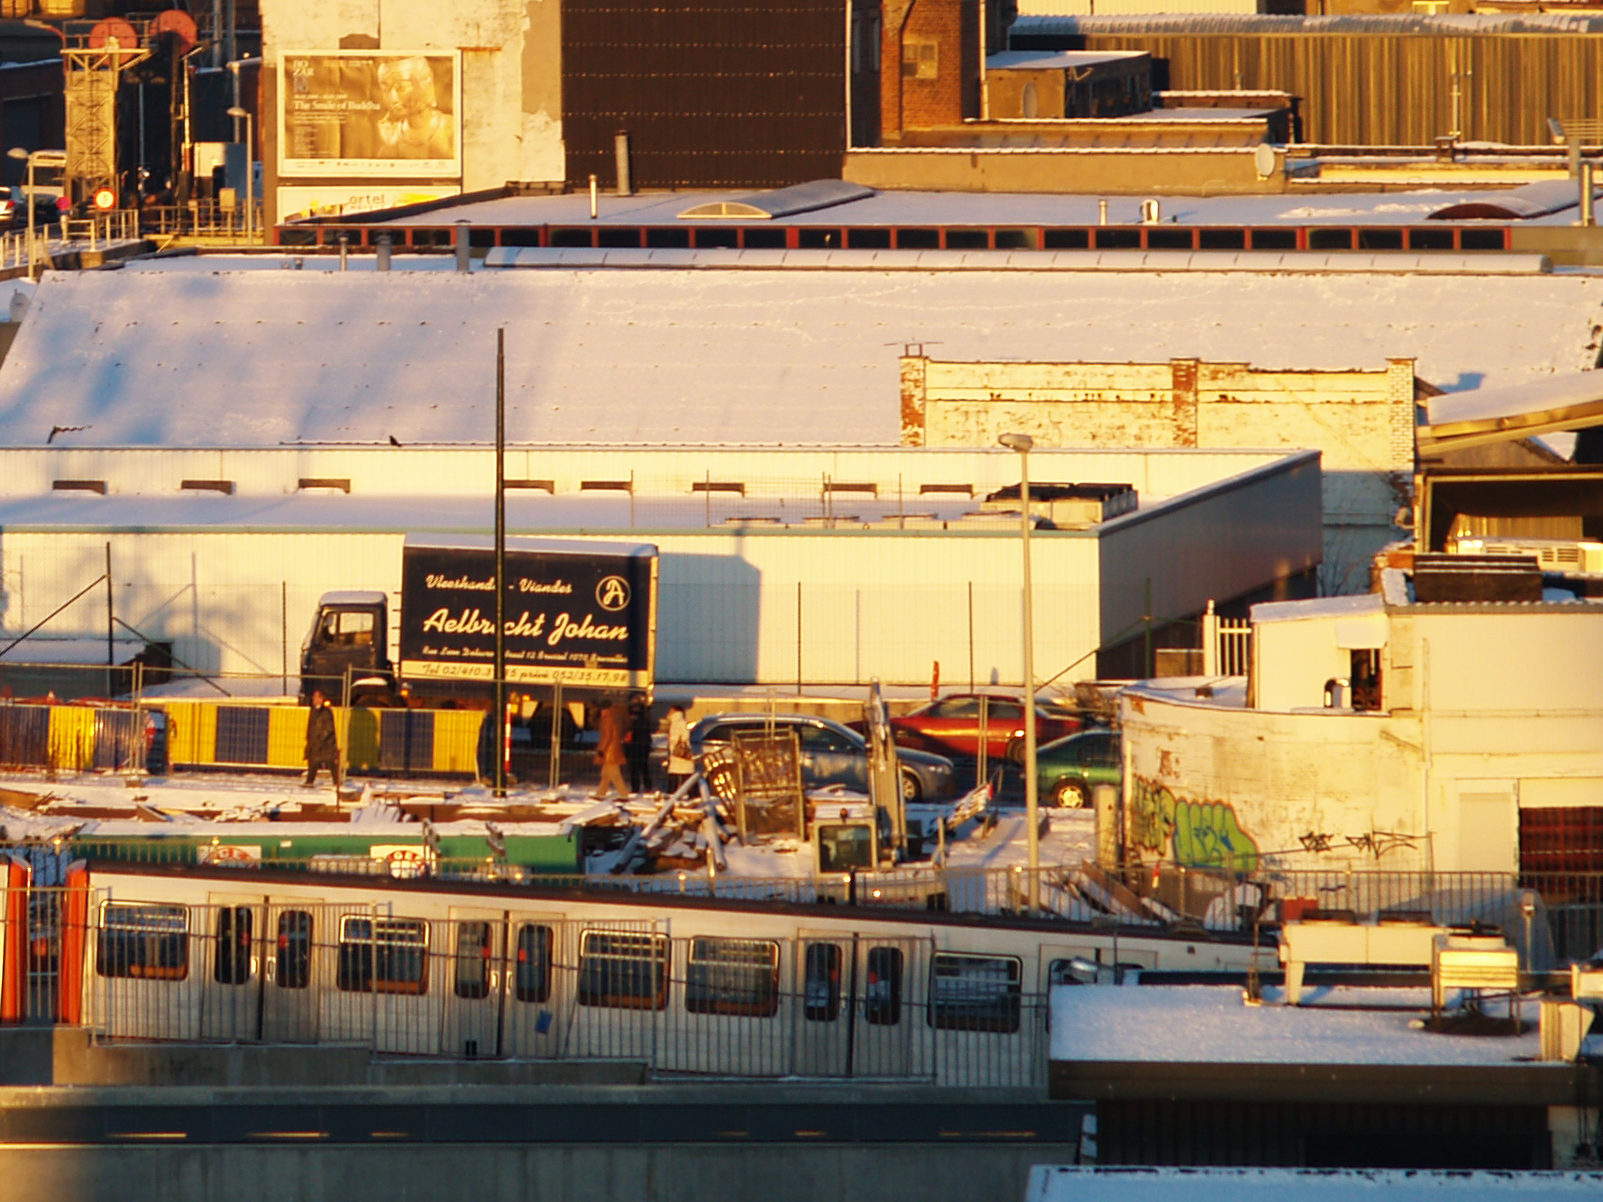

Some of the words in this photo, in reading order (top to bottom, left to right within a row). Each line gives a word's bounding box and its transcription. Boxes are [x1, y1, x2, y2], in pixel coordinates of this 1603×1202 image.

[292, 101, 311, 110] The
[312, 100, 336, 110] Smile
[337, 100, 348, 110] of
[348, 100, 382, 110] Buddha
[349, 194, 385, 204] ortel
[519, 578, 572, 594] Viandes
[548, 612, 629, 646] Johan
